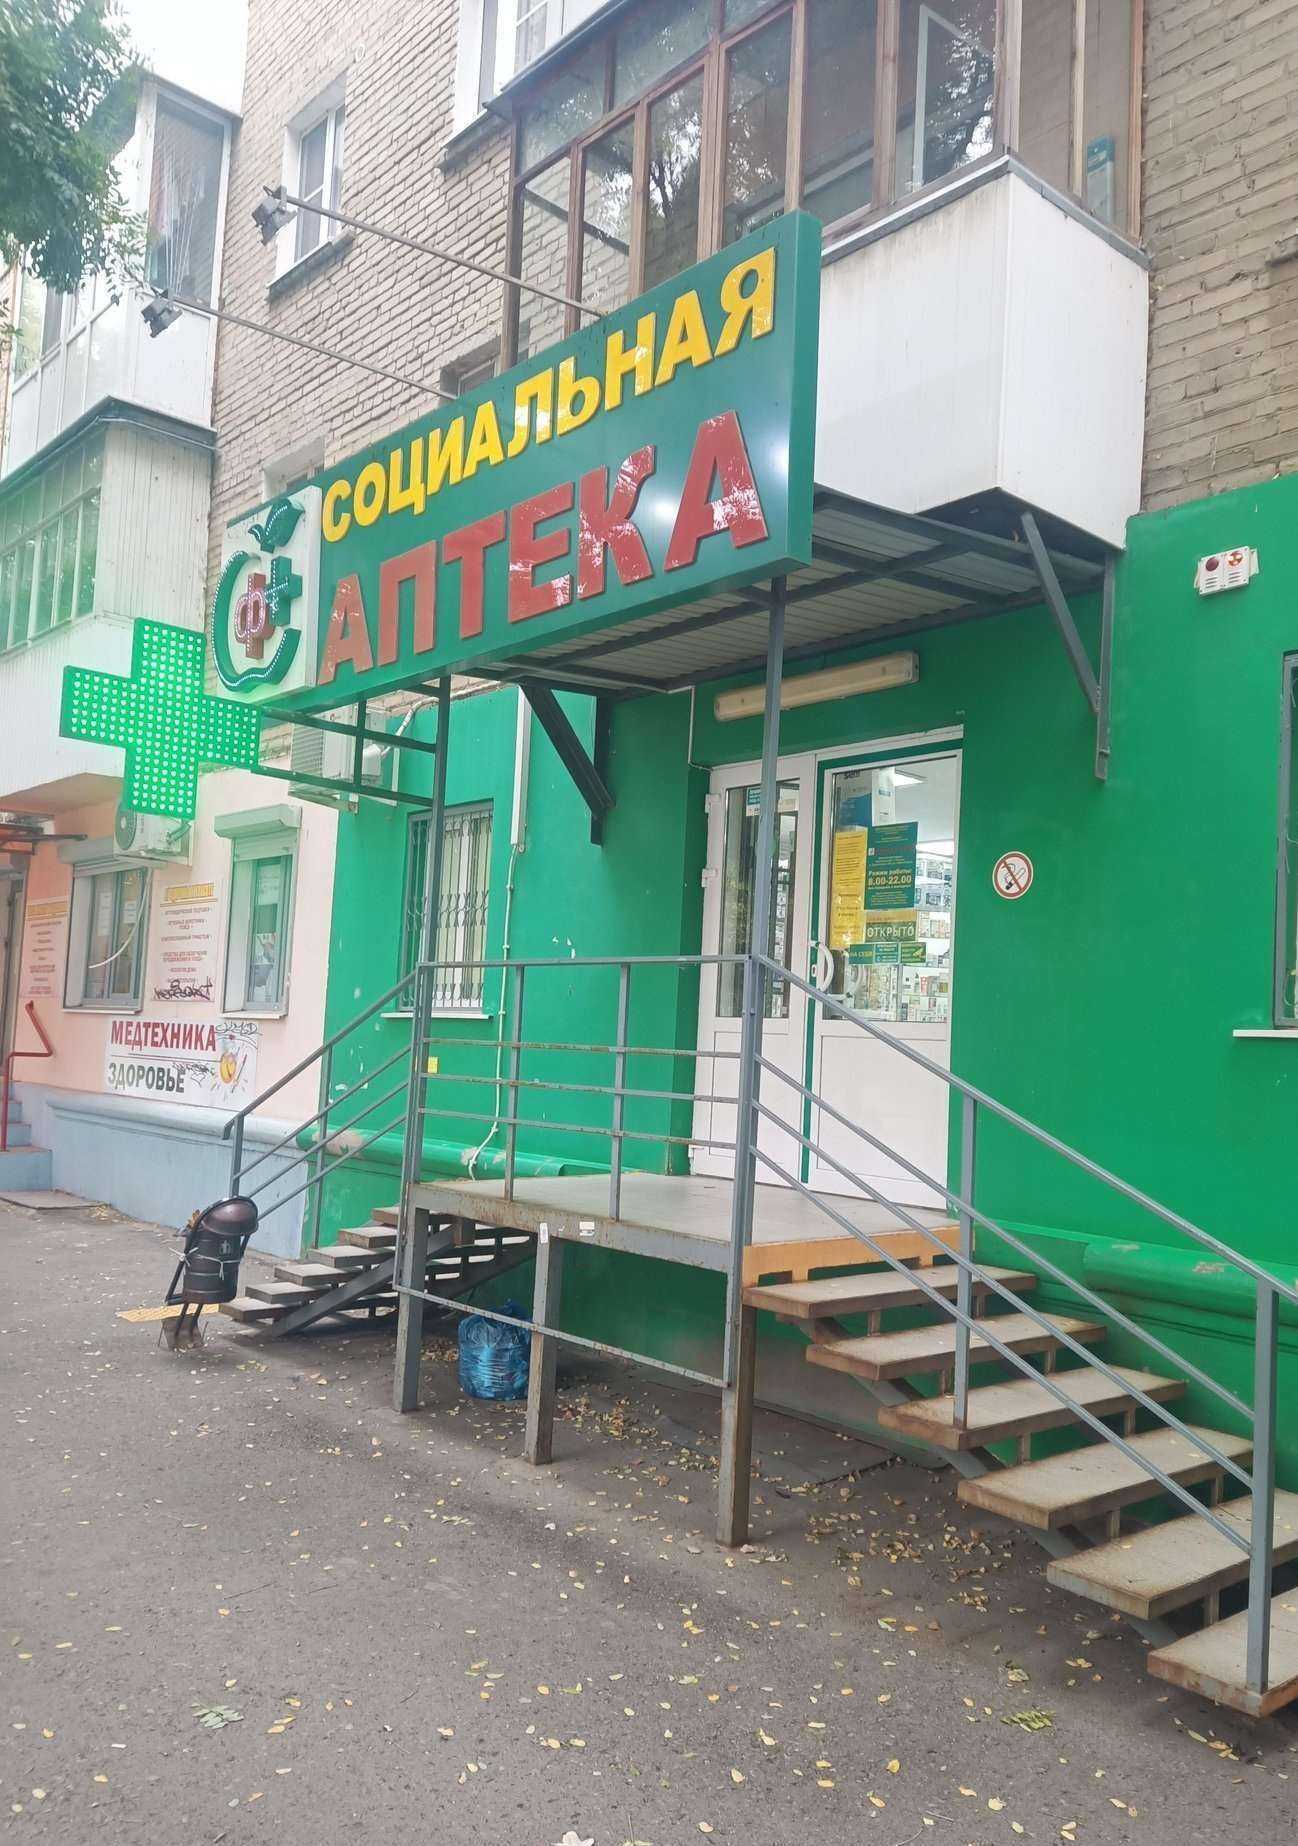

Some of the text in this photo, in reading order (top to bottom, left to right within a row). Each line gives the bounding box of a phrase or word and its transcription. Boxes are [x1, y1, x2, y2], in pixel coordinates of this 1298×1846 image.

[322, 246, 776, 544] СОЦИАЛЬНАЯ
[318, 409, 770, 686] АПТЕКА
[867, 925, 915, 938] ОТКРЫТО
[111, 1020, 217, 1052] МЕДТЕХНИКА
[107, 1062, 186, 1094] ЗДОРОВЬЕ
